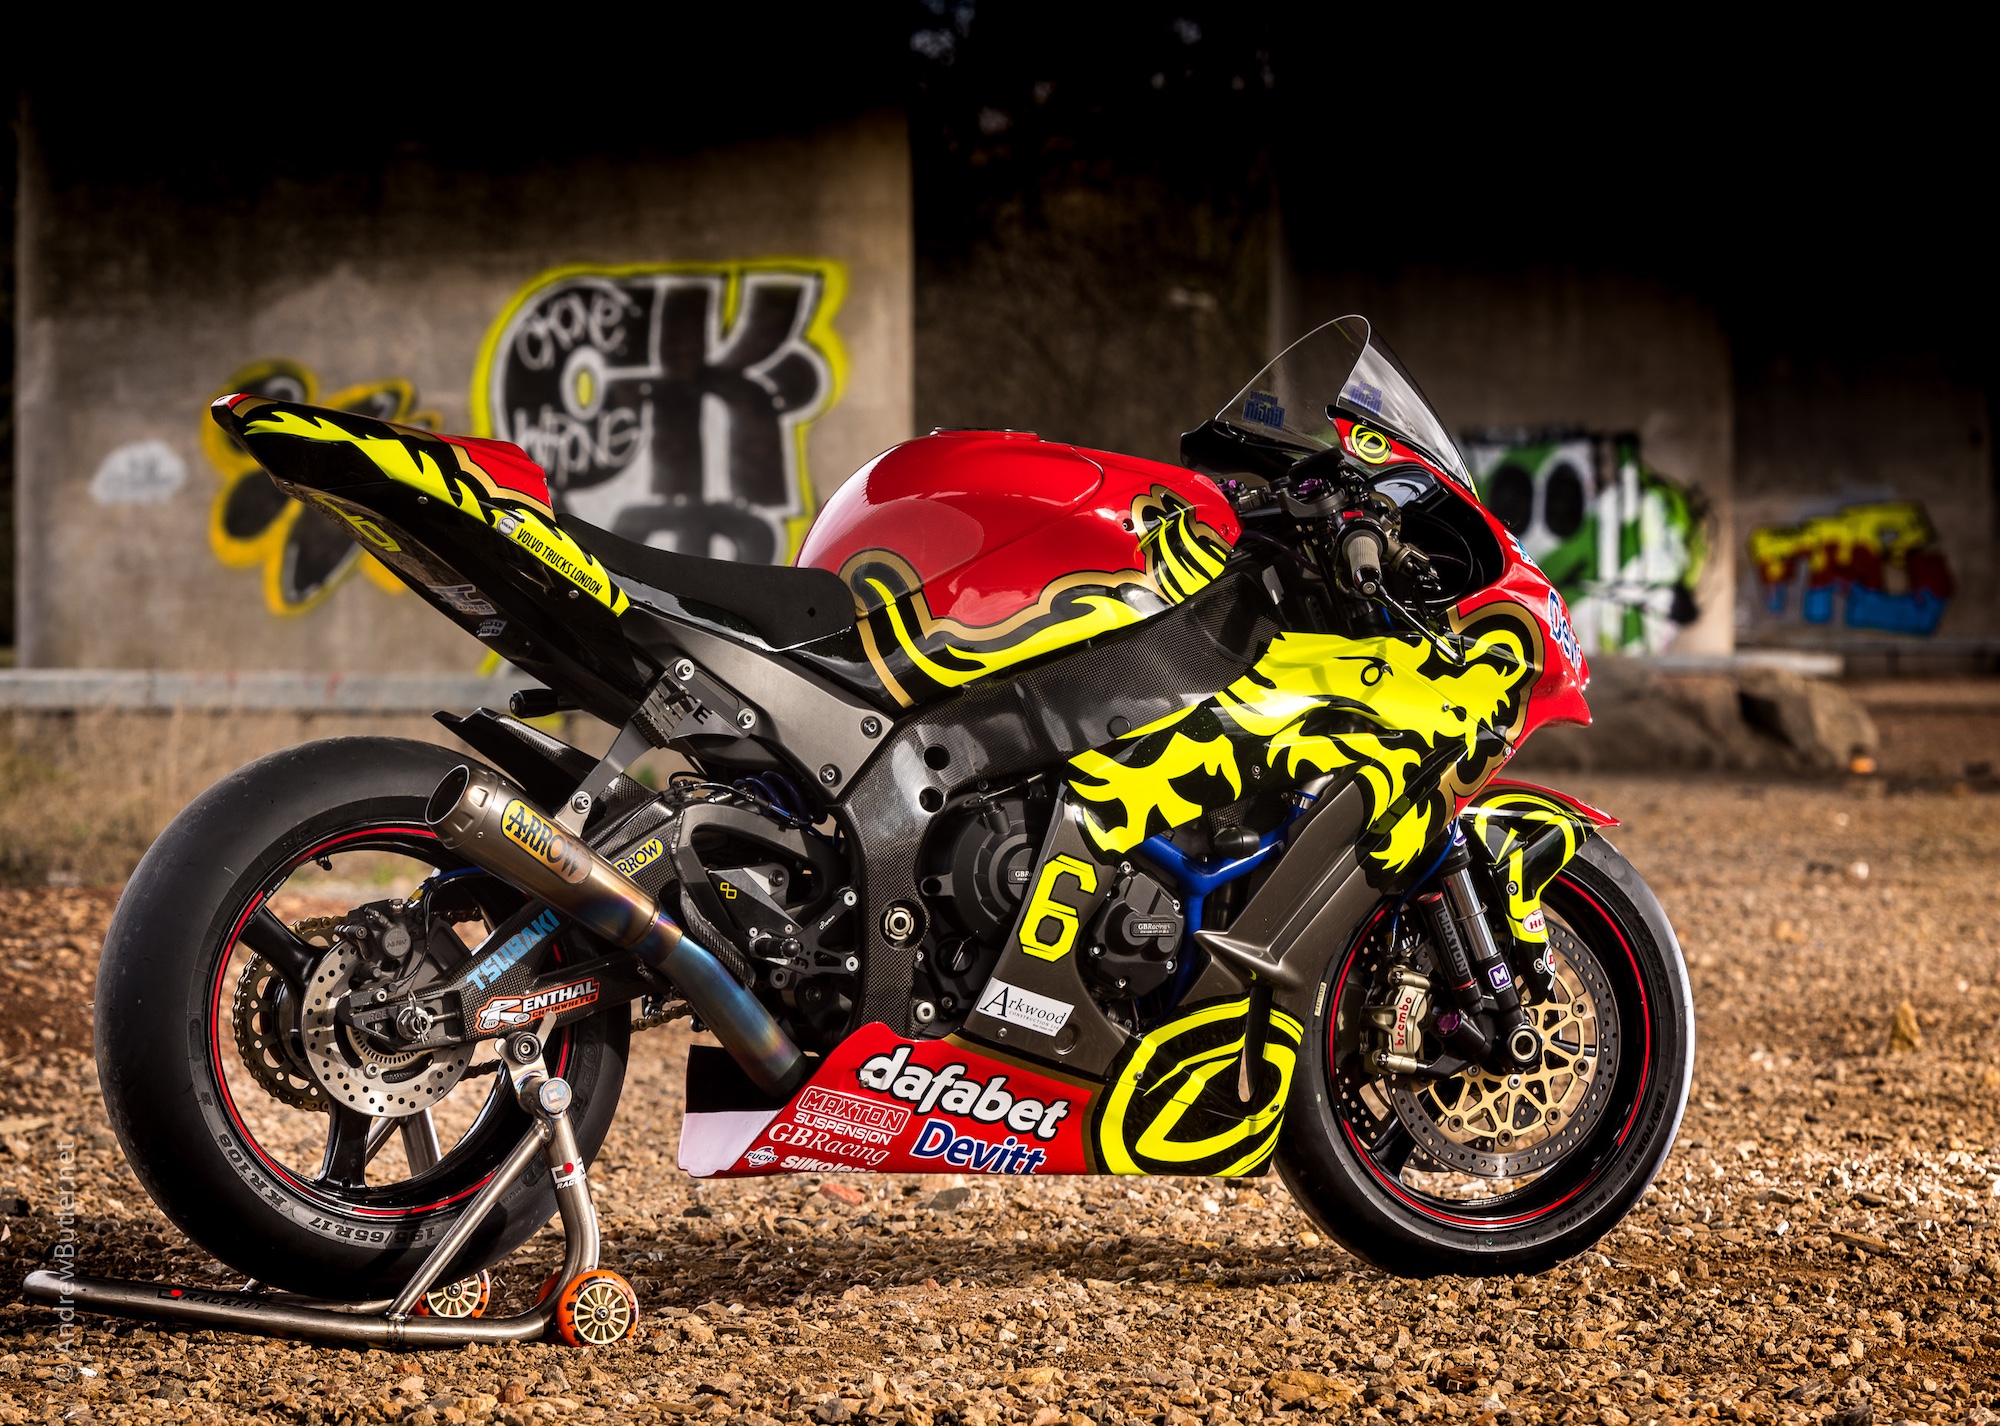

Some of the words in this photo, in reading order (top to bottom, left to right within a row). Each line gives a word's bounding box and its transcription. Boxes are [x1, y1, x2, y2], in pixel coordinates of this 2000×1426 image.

[517, 528, 544, 553] VOLVO
[541, 545, 574, 575] TRUCKS
[570, 566, 603, 595] LONDON
[504, 804, 580, 878] ARROW
[617, 840, 661, 876] RROW
[1019, 852, 1098, 963] 6
[1529, 916, 1546, 930] HE
[466, 908, 561, 991] TSUBAKI
[1437, 910, 1468, 974] MAXTON
[479, 980, 597, 1030] RENTHAL
[979, 986, 1067, 1025] Arkwood
[1009, 1010, 1049, 1027] CONSTRUCTION
[1394, 996, 1413, 1047] brembo
[801, 1089, 905, 1132] MAXTON
[858, 1045, 1070, 1140] dafabet
[768, 1121, 891, 1166] GBRacing
[793, 1111, 893, 1147] SUSPENSION
[909, 1117, 1047, 1175] Devitt
[217, 1132, 290, 1209] KR108
[746, 1151, 778, 1163] FUCHS
